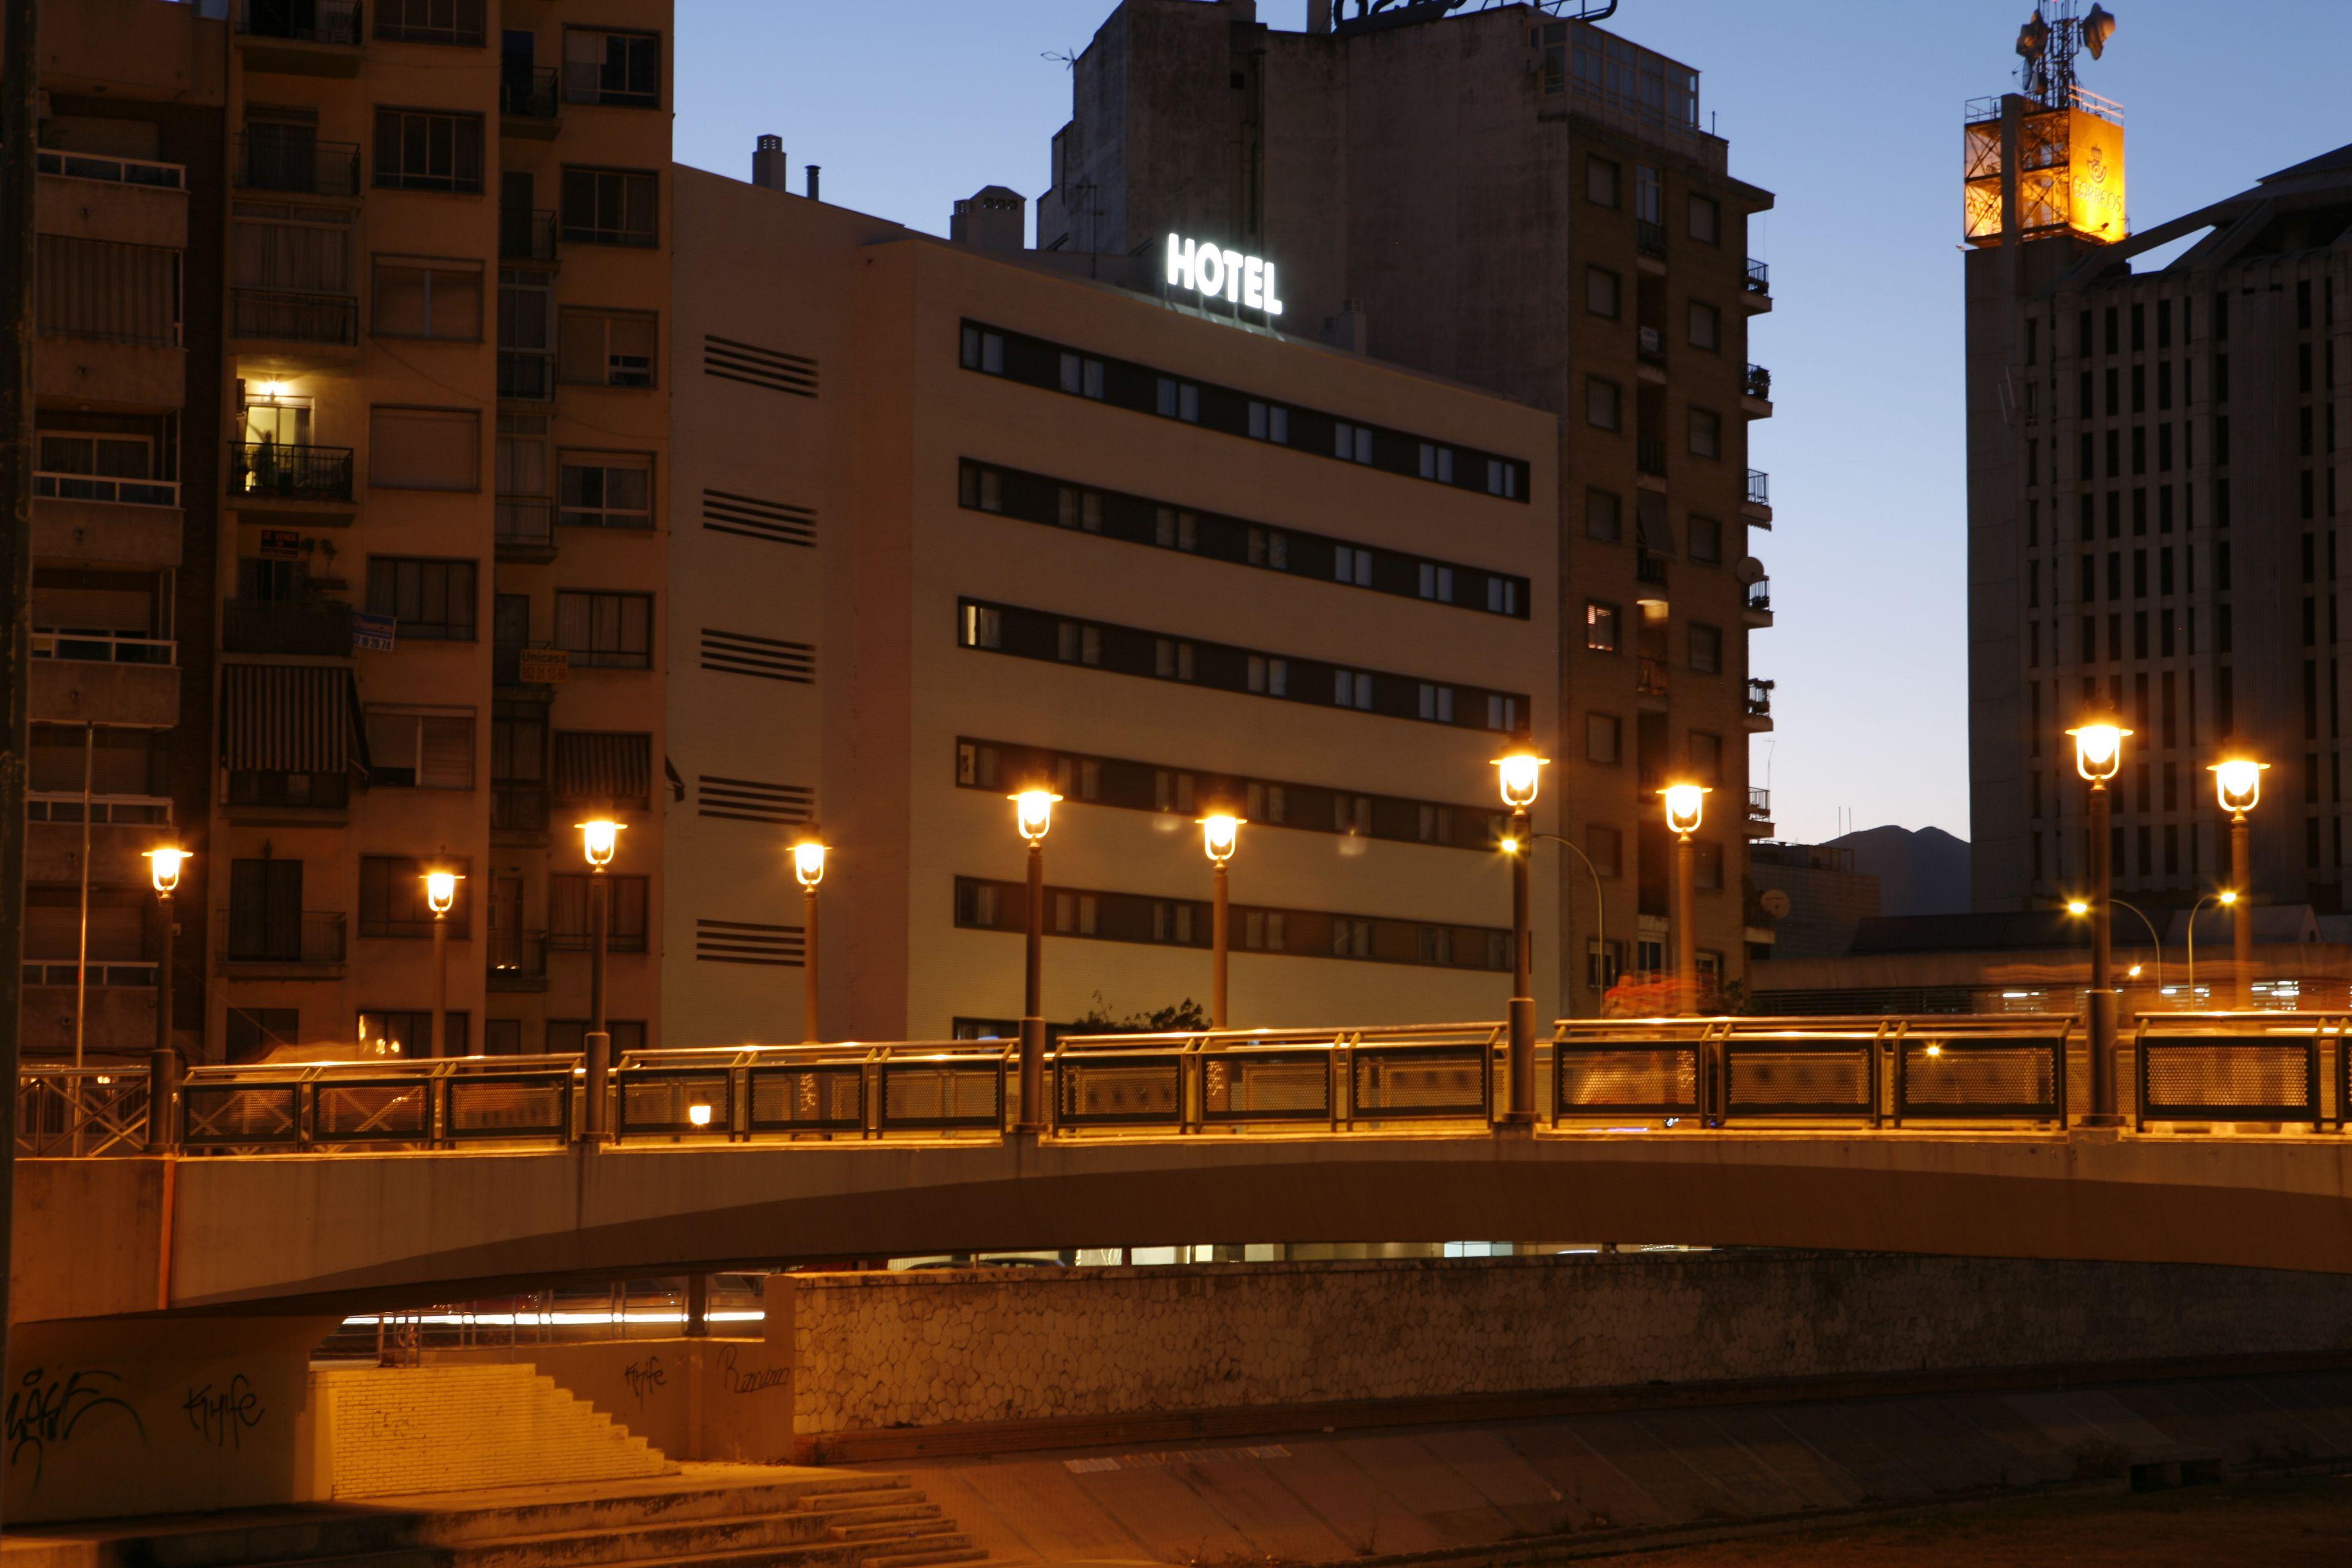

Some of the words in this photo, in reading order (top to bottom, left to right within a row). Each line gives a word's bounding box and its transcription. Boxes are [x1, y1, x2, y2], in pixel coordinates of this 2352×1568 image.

[2072, 175, 2122, 213] CORREOS
[1167, 233, 1283, 315] HOTEL
[521, 650, 567, 663] Unicasa
